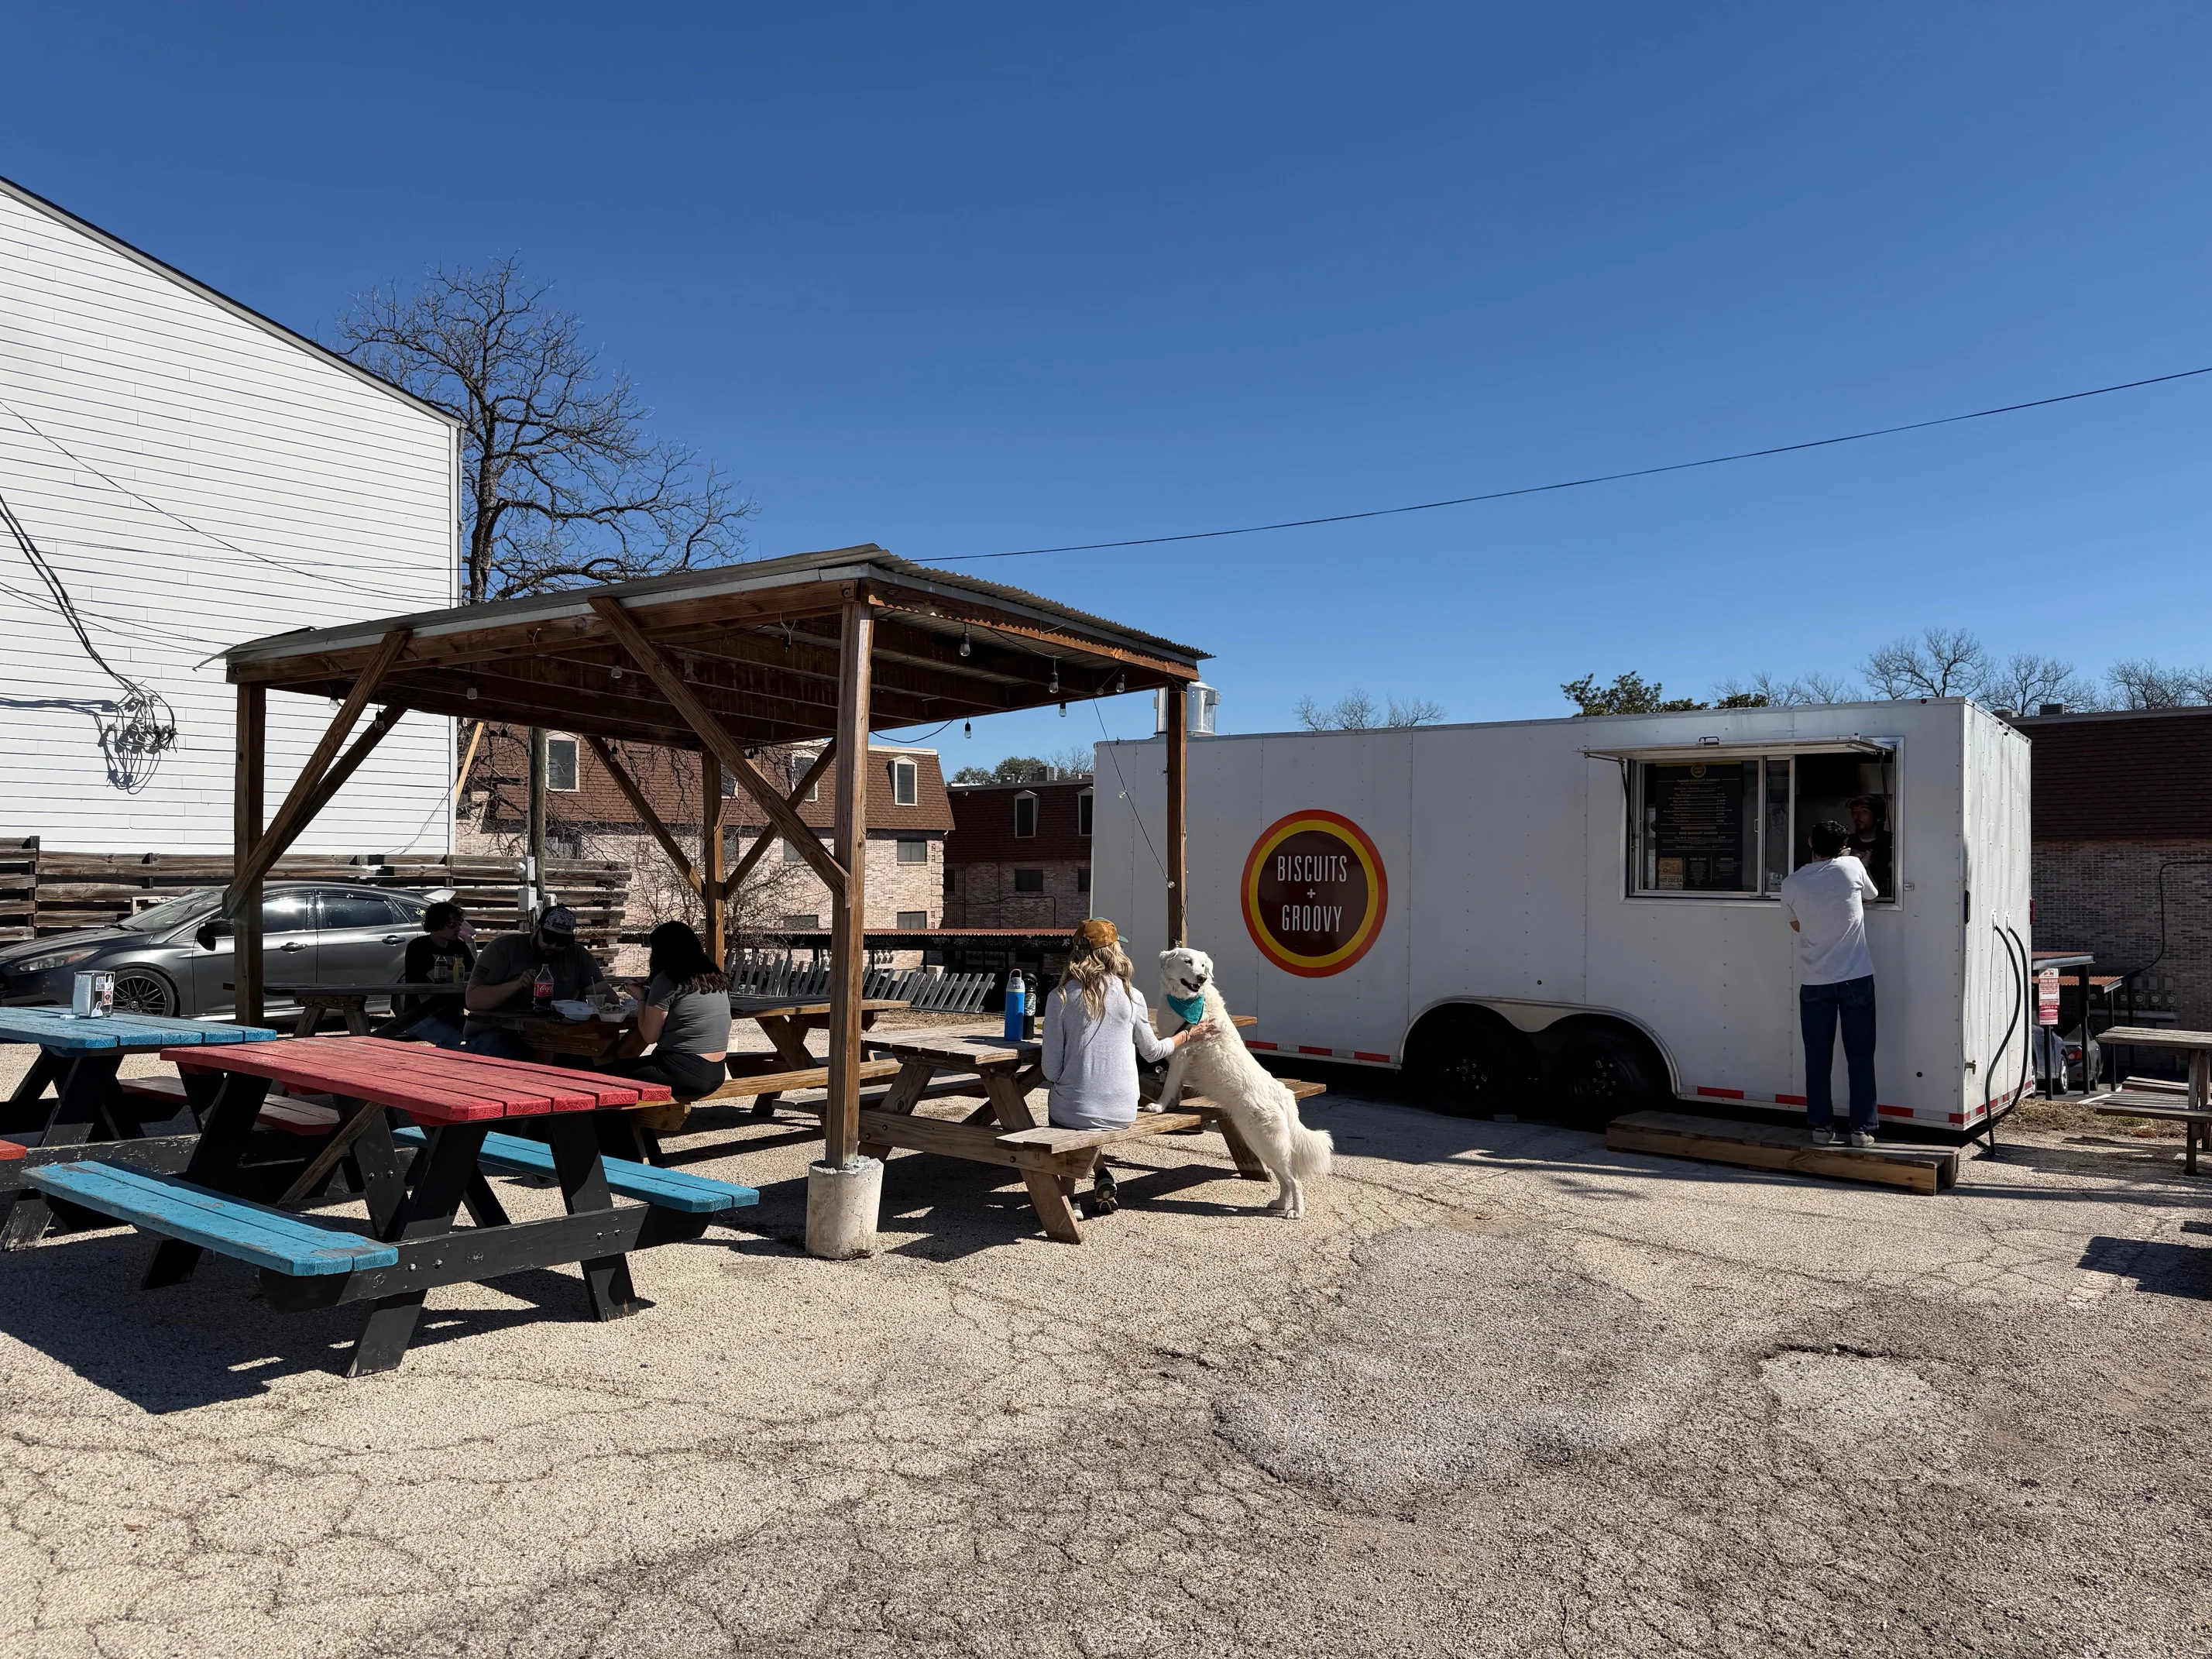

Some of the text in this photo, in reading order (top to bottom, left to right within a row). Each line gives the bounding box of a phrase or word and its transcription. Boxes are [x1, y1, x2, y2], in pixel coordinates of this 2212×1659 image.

[1277, 855, 1348, 882] BISCUITS
[1307, 888, 1316, 898] +
[1282, 905, 1342, 933] GROOVY
